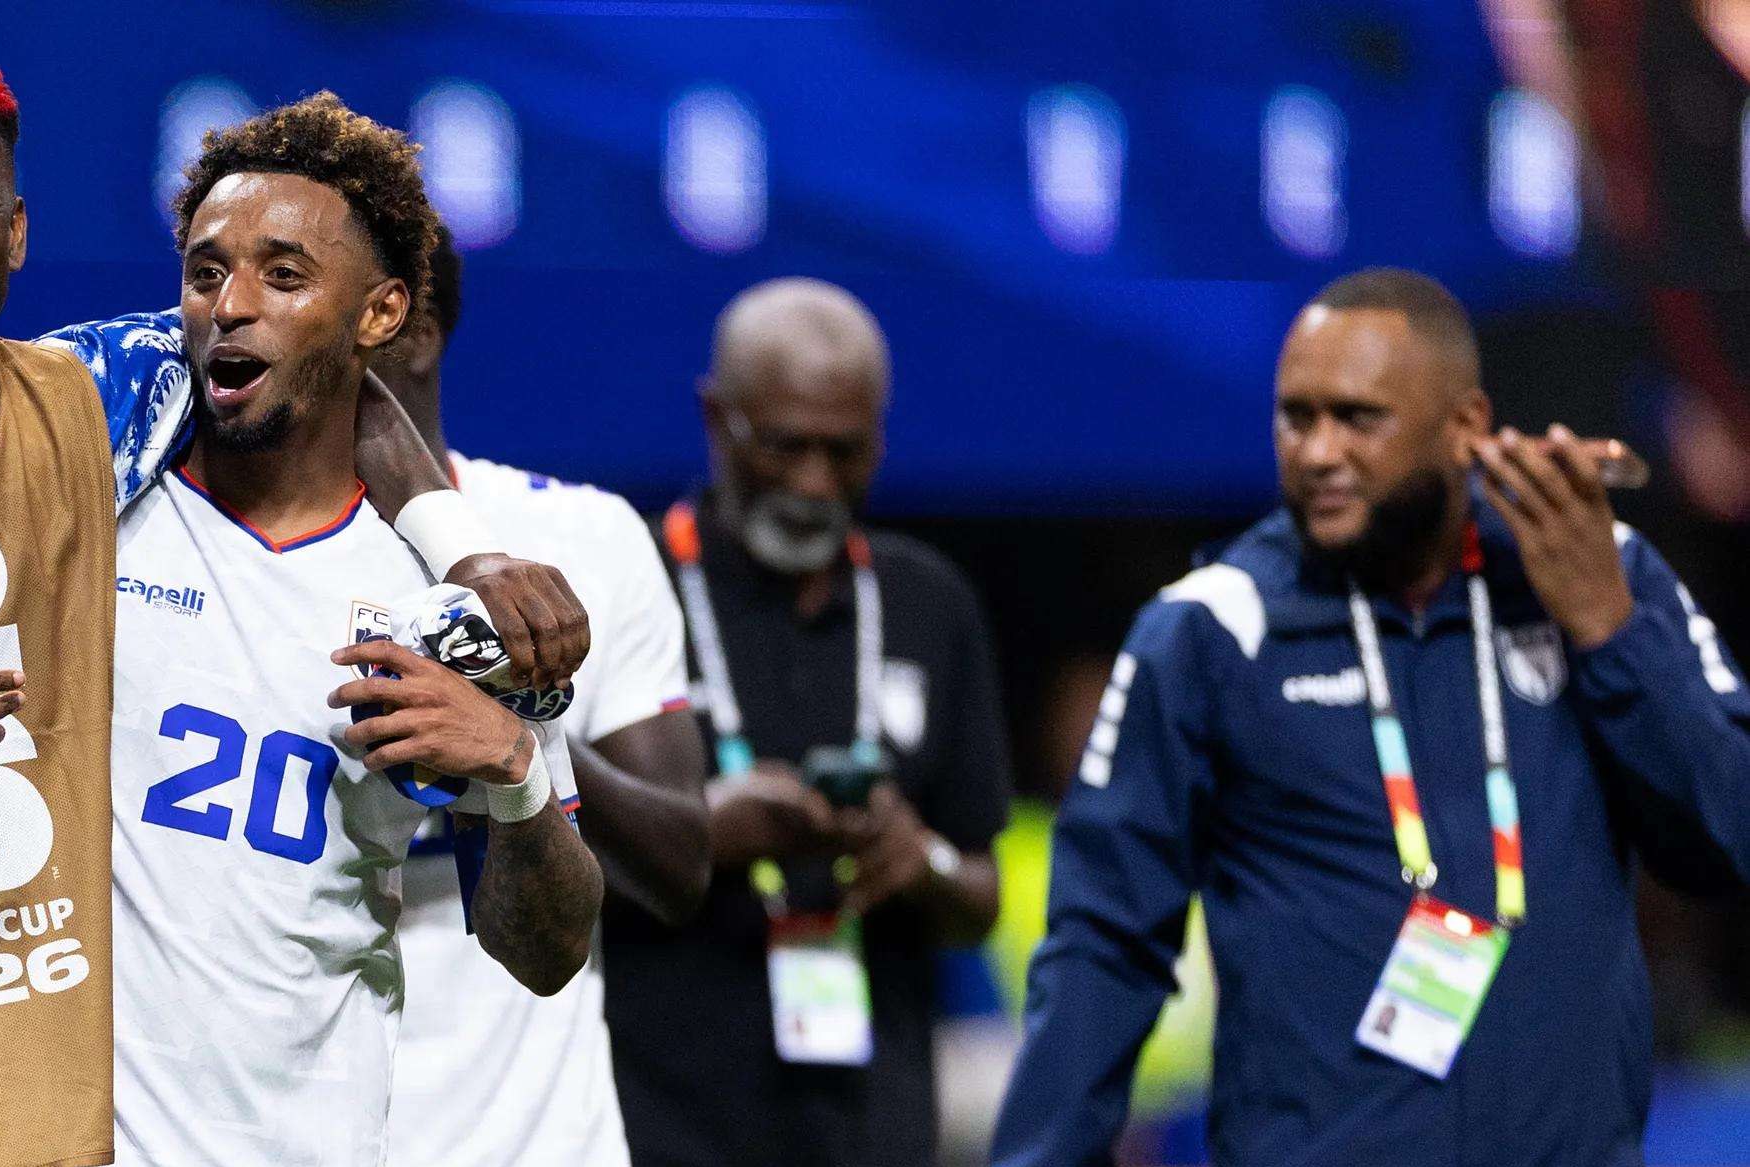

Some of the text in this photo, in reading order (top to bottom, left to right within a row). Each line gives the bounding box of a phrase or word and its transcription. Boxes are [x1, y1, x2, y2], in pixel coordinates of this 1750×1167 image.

[115, 576, 206, 612] capelli
[357, 607, 389, 626] FC
[141, 702, 341, 866] 20
